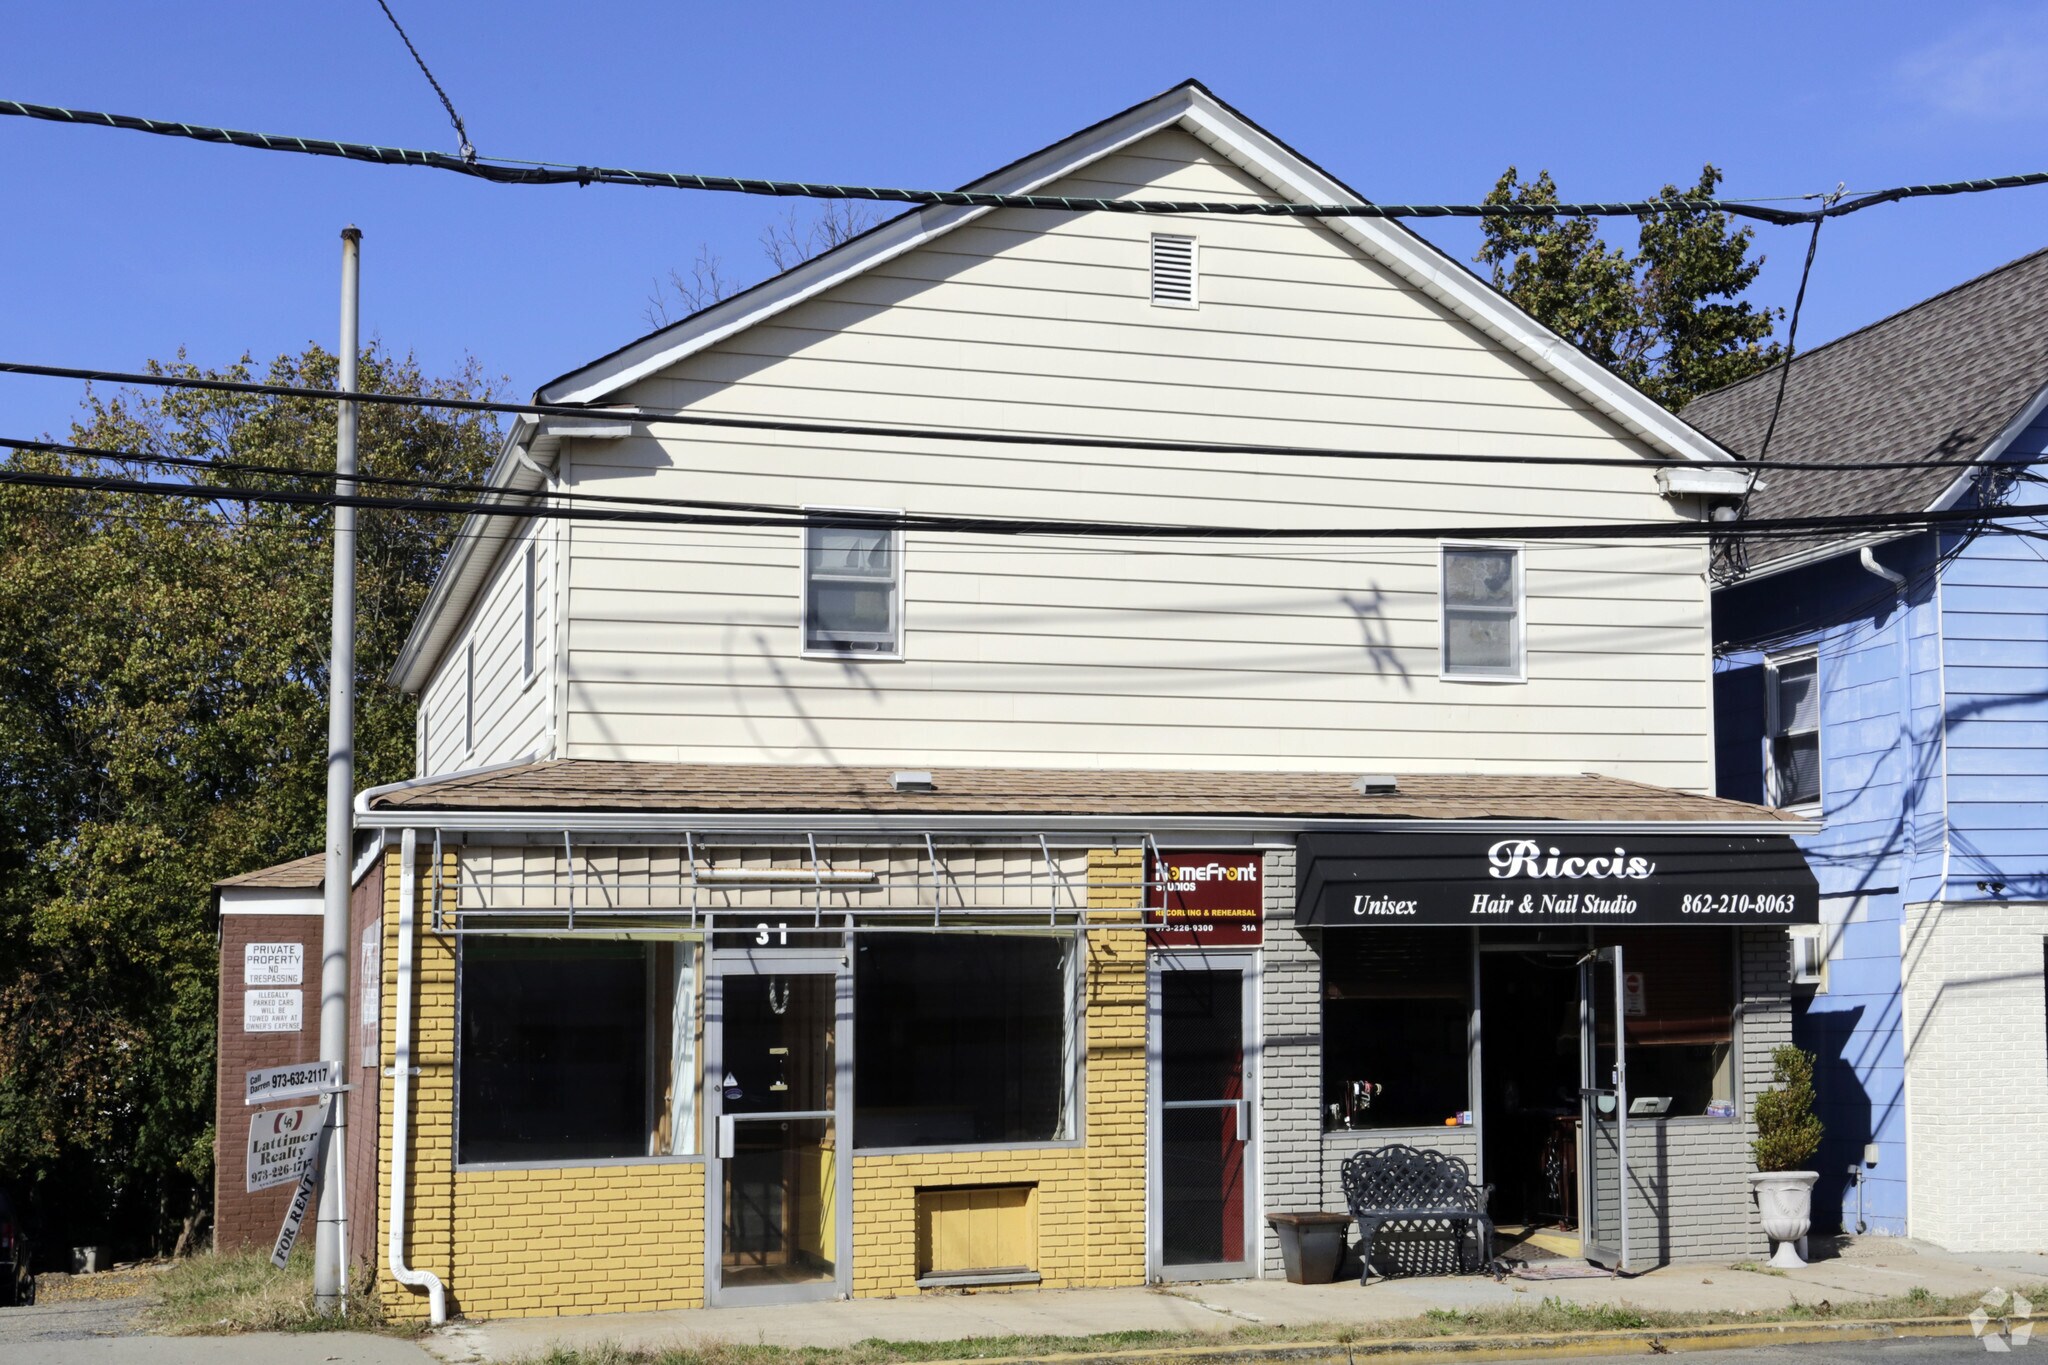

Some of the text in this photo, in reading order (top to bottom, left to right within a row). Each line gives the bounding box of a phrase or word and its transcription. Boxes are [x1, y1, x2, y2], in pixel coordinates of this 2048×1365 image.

[1488, 839, 1655, 879] Riccis
[1353, 894, 1795, 915] Unisex Hair & Nail Studio 862-210-8063
[1203, 909, 1210, 917] &
[1211, 909, 1257, 917] REHEARSAL
[755, 923, 787, 945] 31
[1241, 924, 1257, 932] 31A
[253, 945, 295, 954] PRIVATE
[247, 955, 301, 964] PROPERTY
[268, 965, 279, 973] NO
[249, 974, 298, 983] TRESPASSING
[274, 1022, 300, 1030] EXPENSE
[250, 1073, 262, 1085] Call
[250, 1068, 328, 1094] Darren 973-632-2117
[253, 1132, 318, 1153] Lattimer
[260, 1146, 306, 1165] Realty
[276, 1174, 315, 1262] FOR RENT
